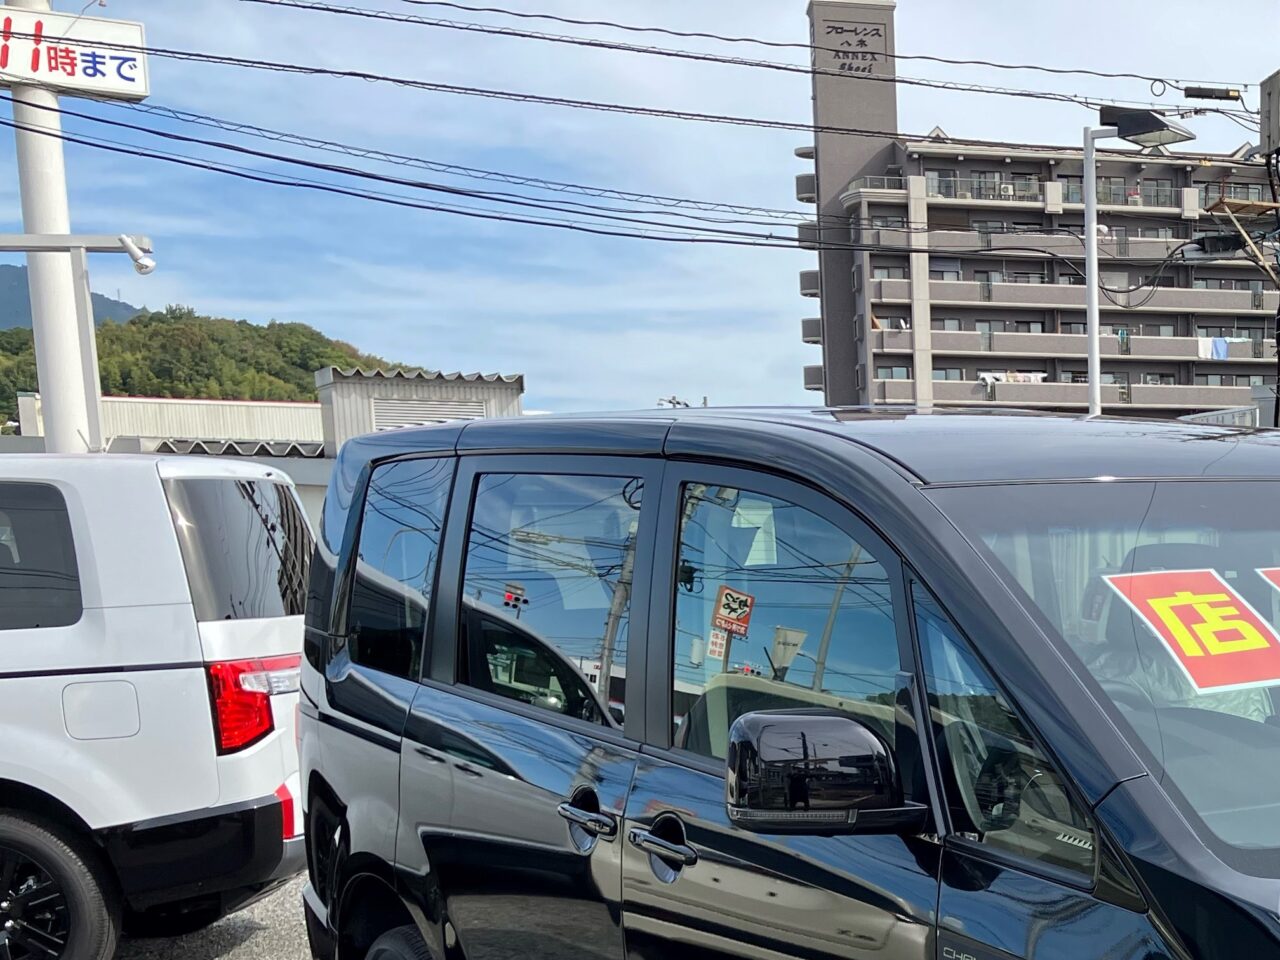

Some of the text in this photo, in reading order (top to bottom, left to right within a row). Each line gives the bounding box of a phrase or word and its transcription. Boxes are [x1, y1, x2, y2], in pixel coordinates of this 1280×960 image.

[826, 25, 883, 37] フローレンス
[833, 51, 878, 62] ANNEX
